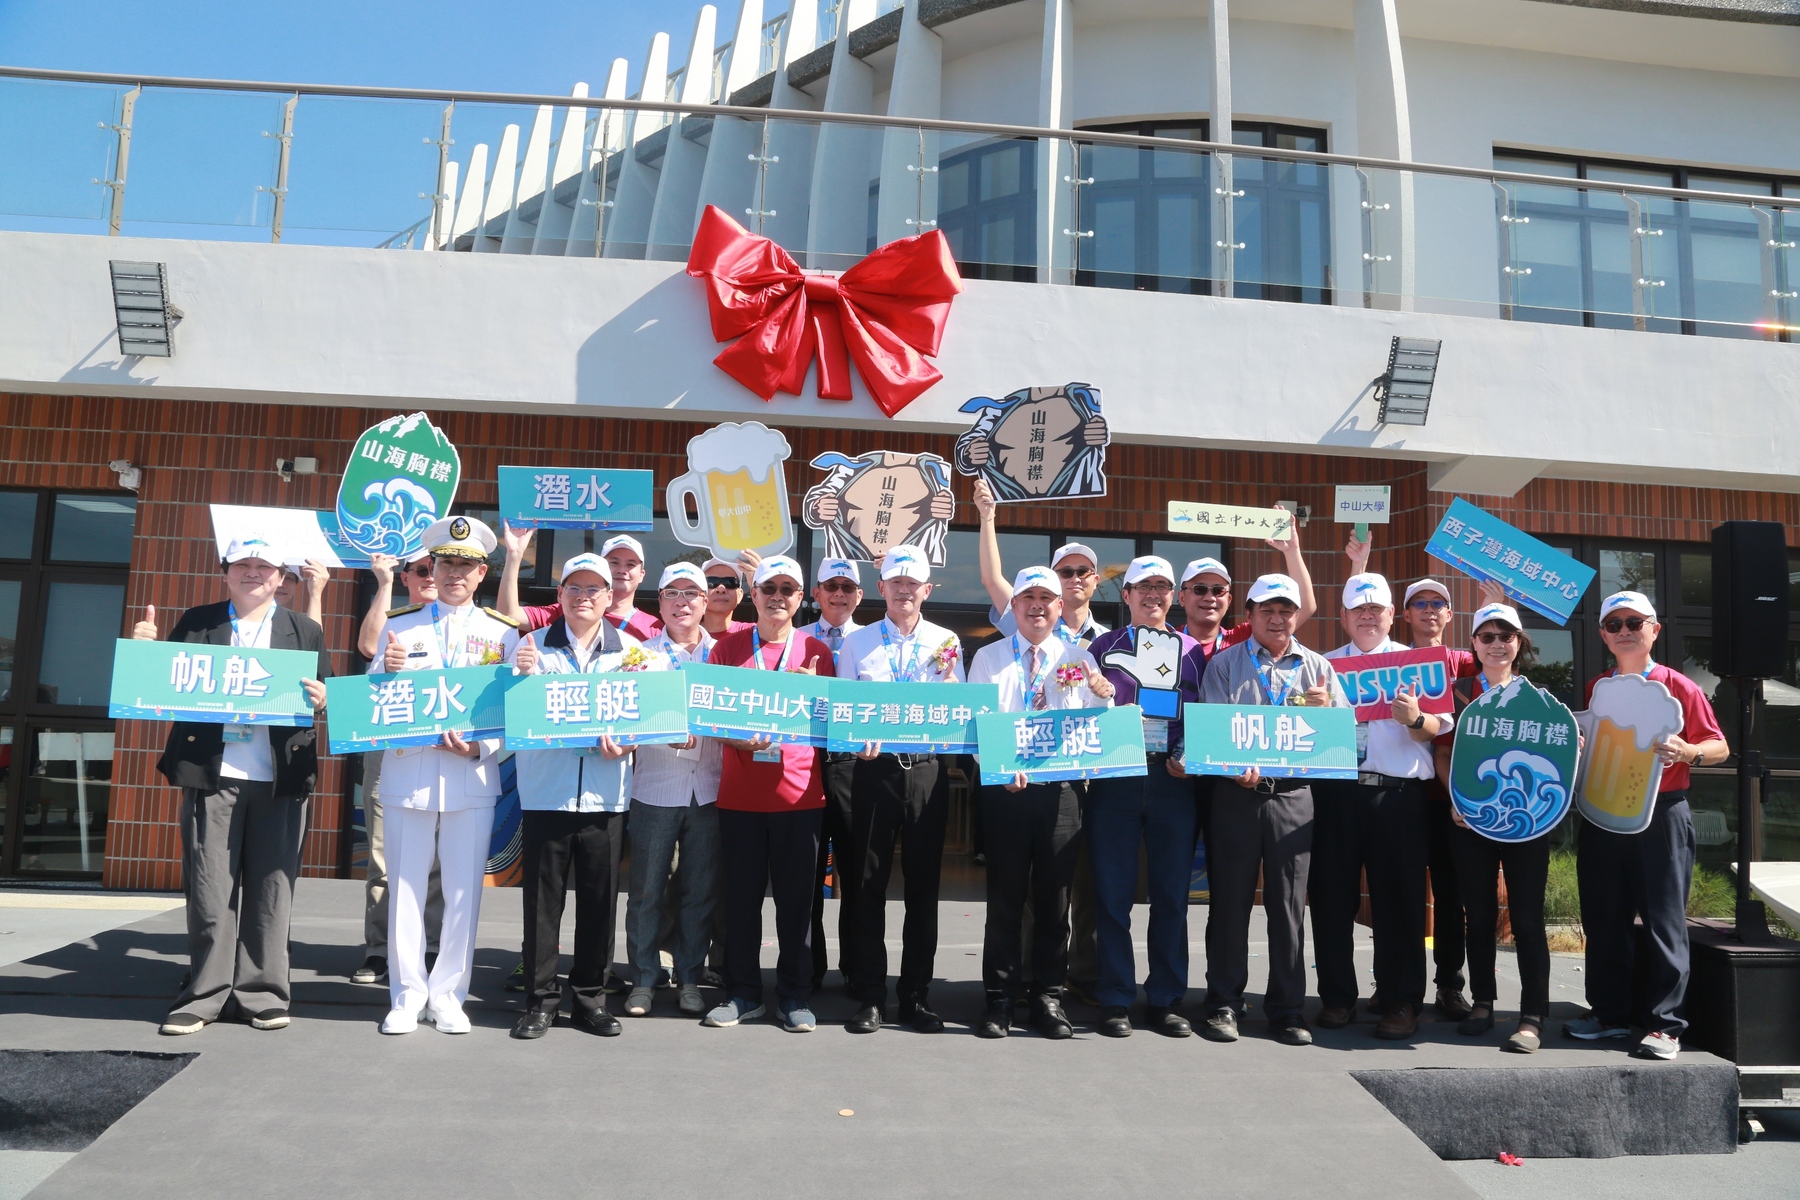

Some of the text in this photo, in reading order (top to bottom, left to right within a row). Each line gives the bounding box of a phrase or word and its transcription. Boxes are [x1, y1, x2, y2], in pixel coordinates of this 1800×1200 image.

[361, 440, 452, 483] 山海胸襟
[1027, 409, 1047, 481] 山海胸襟
[533, 473, 613, 511] 潛水
[873, 475, 897, 544] 山海胸襟
[1340, 500, 1385, 512] 中山大學
[1196, 511, 1286, 531] 國立中山大學
[1441, 516, 1579, 600] 西子灣海域中心
[369, 675, 468, 726] 潛水
[545, 678, 641, 726] 輕艇
[1013, 715, 1103, 760] 輕艇
[1465, 715, 1570, 746] 山海胸襟
